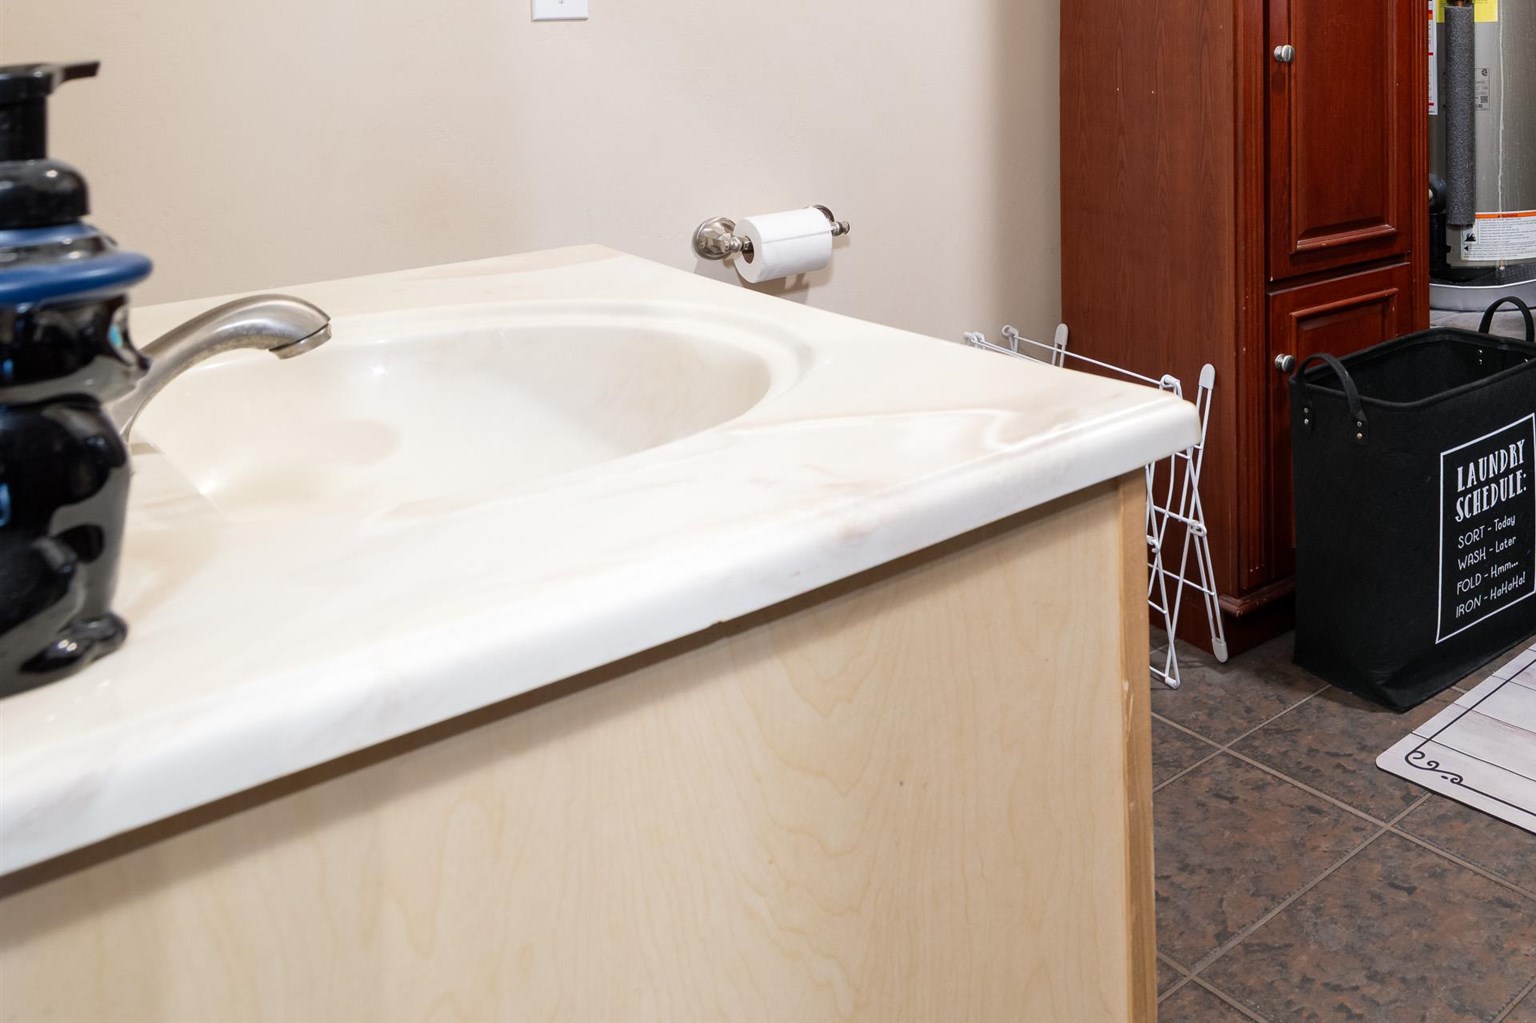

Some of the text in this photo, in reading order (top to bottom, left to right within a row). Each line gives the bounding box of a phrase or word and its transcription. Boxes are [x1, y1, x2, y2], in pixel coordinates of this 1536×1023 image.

[1456, 438, 1527, 493] LAUNDRY
[1454, 471, 1528, 523] SCHEDULE:
[1457, 526, 1486, 550] SORT
[1494, 514, 1516, 532] Today
[1457, 546, 1487, 571] WASH
[1495, 535, 1517, 553] Later
[1455, 595, 1482, 618] IRON
[1490, 571, 1527, 601] HaHaHa!
[1457, 573, 1482, 596] FOLD
[1490, 560, 1519, 578] Hmm...
